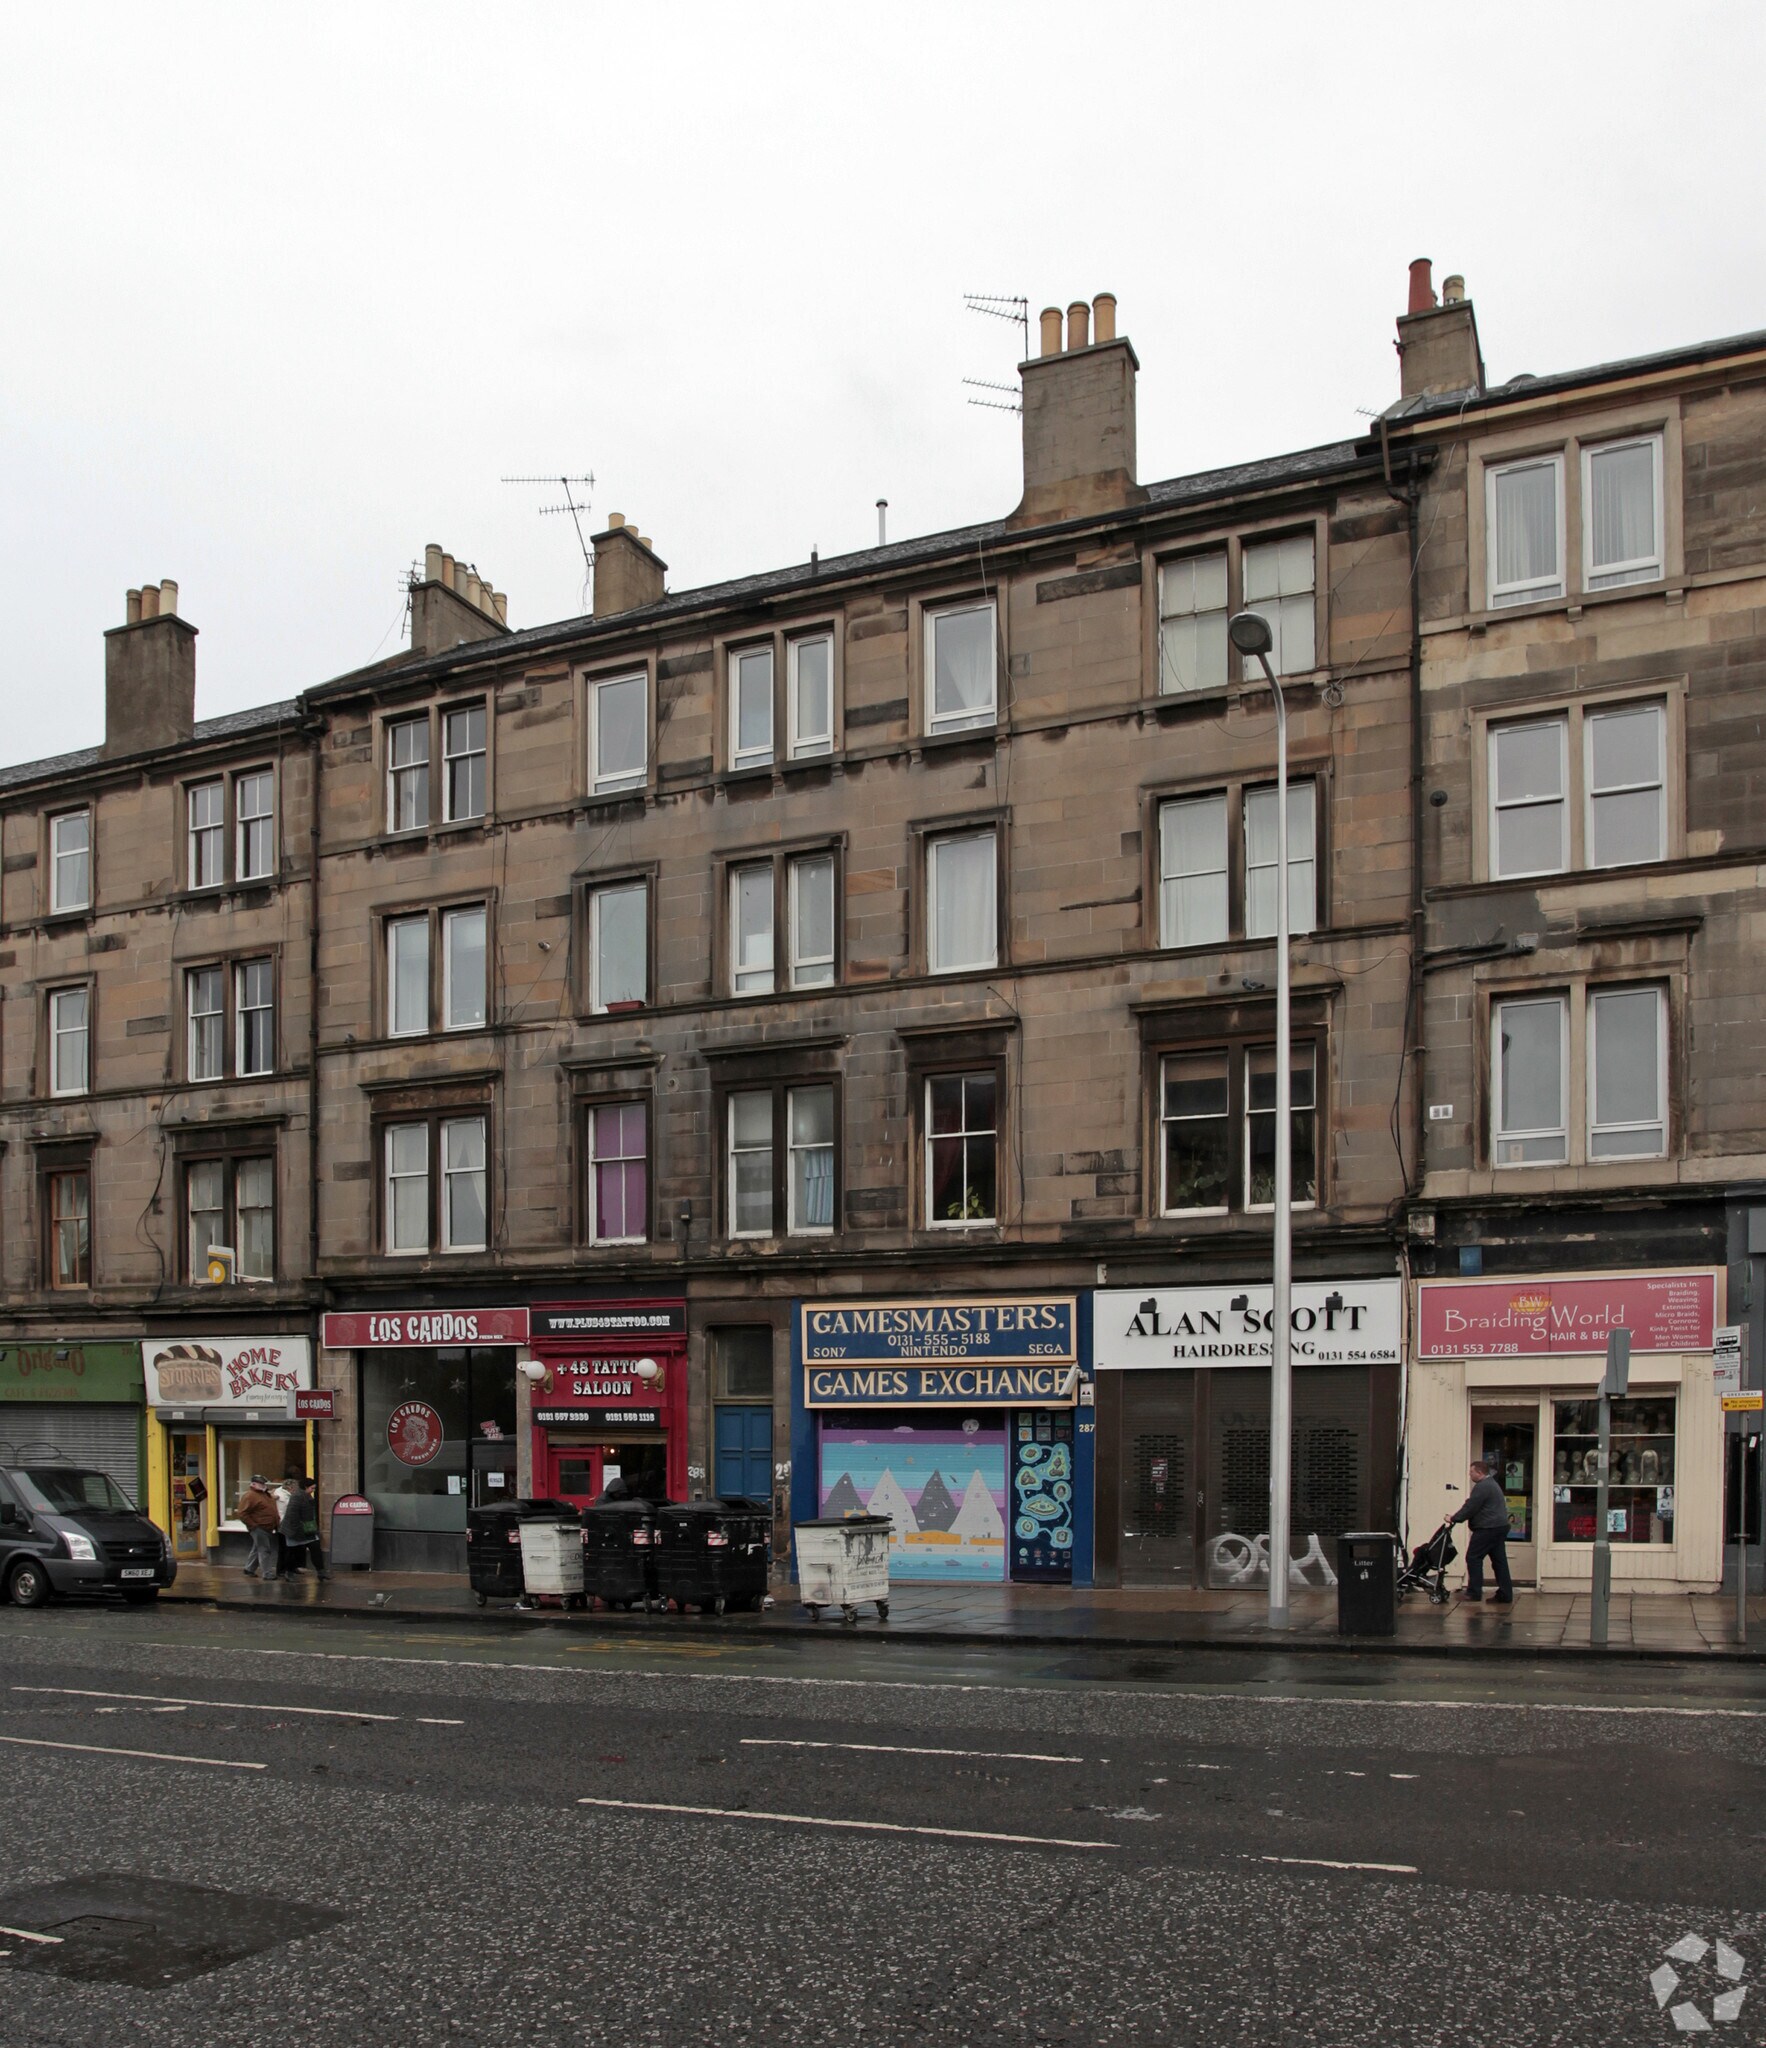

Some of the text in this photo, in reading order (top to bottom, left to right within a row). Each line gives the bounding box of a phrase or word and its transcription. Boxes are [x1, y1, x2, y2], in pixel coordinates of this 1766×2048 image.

[1647, 1282, 1687, 1290] Specialists
[812, 1306, 1065, 1335] GAMESMASTERS.
[1125, 1310, 1223, 1337] ALAN
[1445, 1304, 1625, 1341] Braiding World
[369, 1313, 479, 1344] LOS CARDOS
[1550, 1330, 1636, 1341] HAIR & BEY
[813, 1347, 847, 1358] SONY
[901, 1345, 967, 1357] NINTENDO
[1028, 1344, 1064, 1355] SEGA
[1173, 1341, 1316, 1358] HAIRDRESNG
[1318, 1350, 1396, 1361] 0131 554 6584
[1431, 1342, 1519, 1355] 0131 553 7788
[226, 1347, 282, 1378] HOME
[592, 1360, 639, 1374] TATTO
[160, 1366, 219, 1386] STORRIES
[229, 1367, 300, 1399] BAKERY
[813, 1368, 1073, 1396] GAMES EXCHANGE
[573, 1380, 633, 1395] SALOON
[297, 1398, 332, 1410] LOS CARDOS
[400, 1404, 431, 1419] CARDOS
[389, 1416, 401, 1434] LOS
[1079, 1424, 1095, 1433] 287
